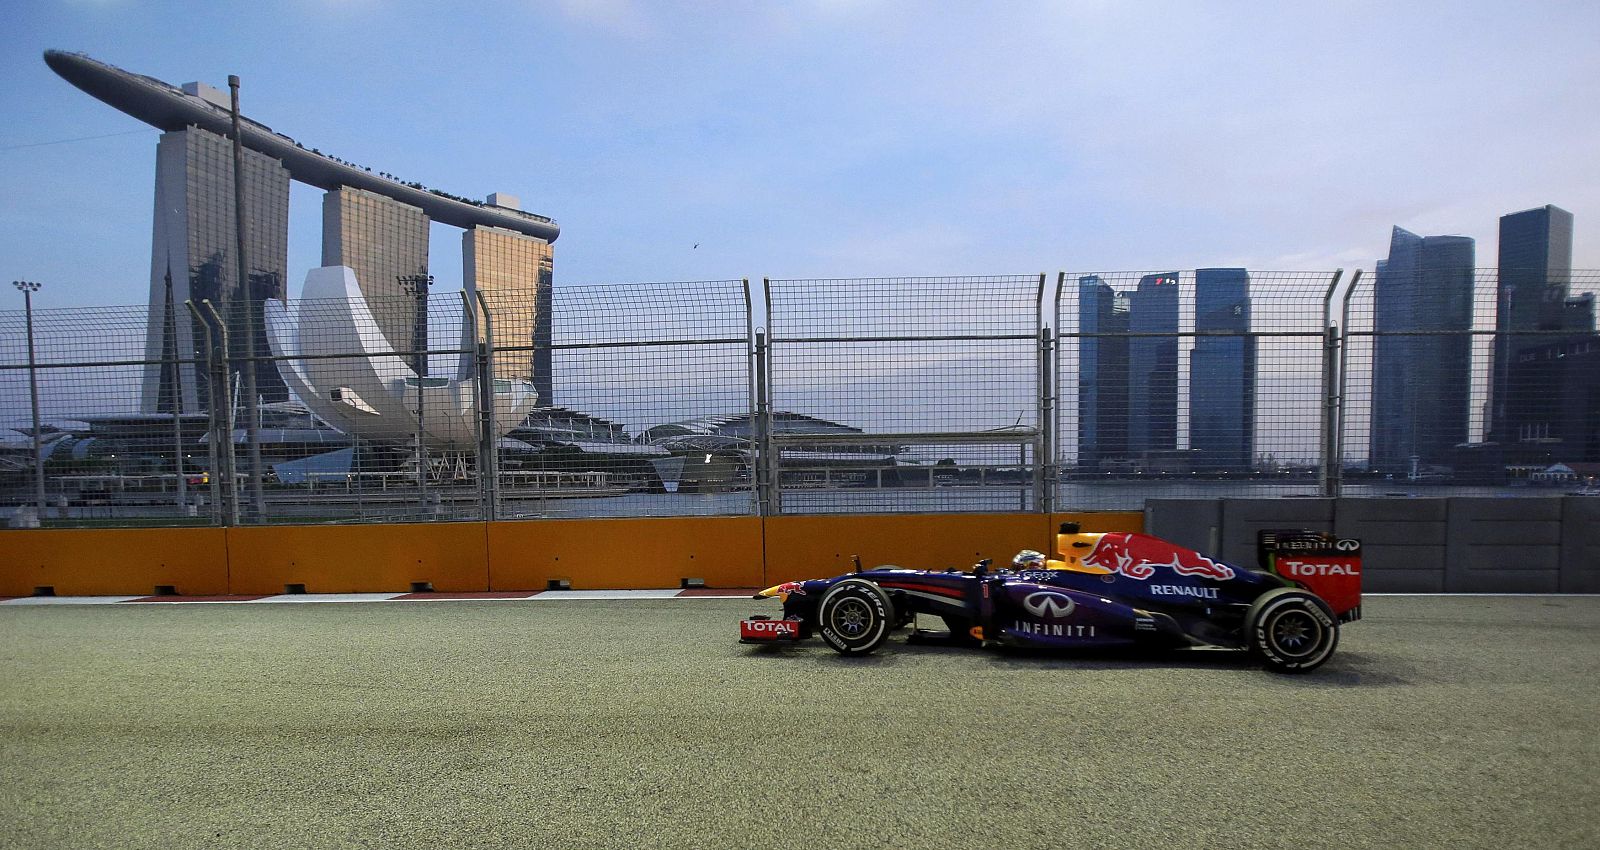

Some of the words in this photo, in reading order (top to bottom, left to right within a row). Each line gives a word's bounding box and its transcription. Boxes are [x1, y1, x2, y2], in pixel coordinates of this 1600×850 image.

[1286, 562, 1359, 575] TOTAL
[1150, 585, 1220, 598] RENAULT
[743, 620, 795, 632] TOTAL
[1015, 620, 1095, 637] INFINITI
